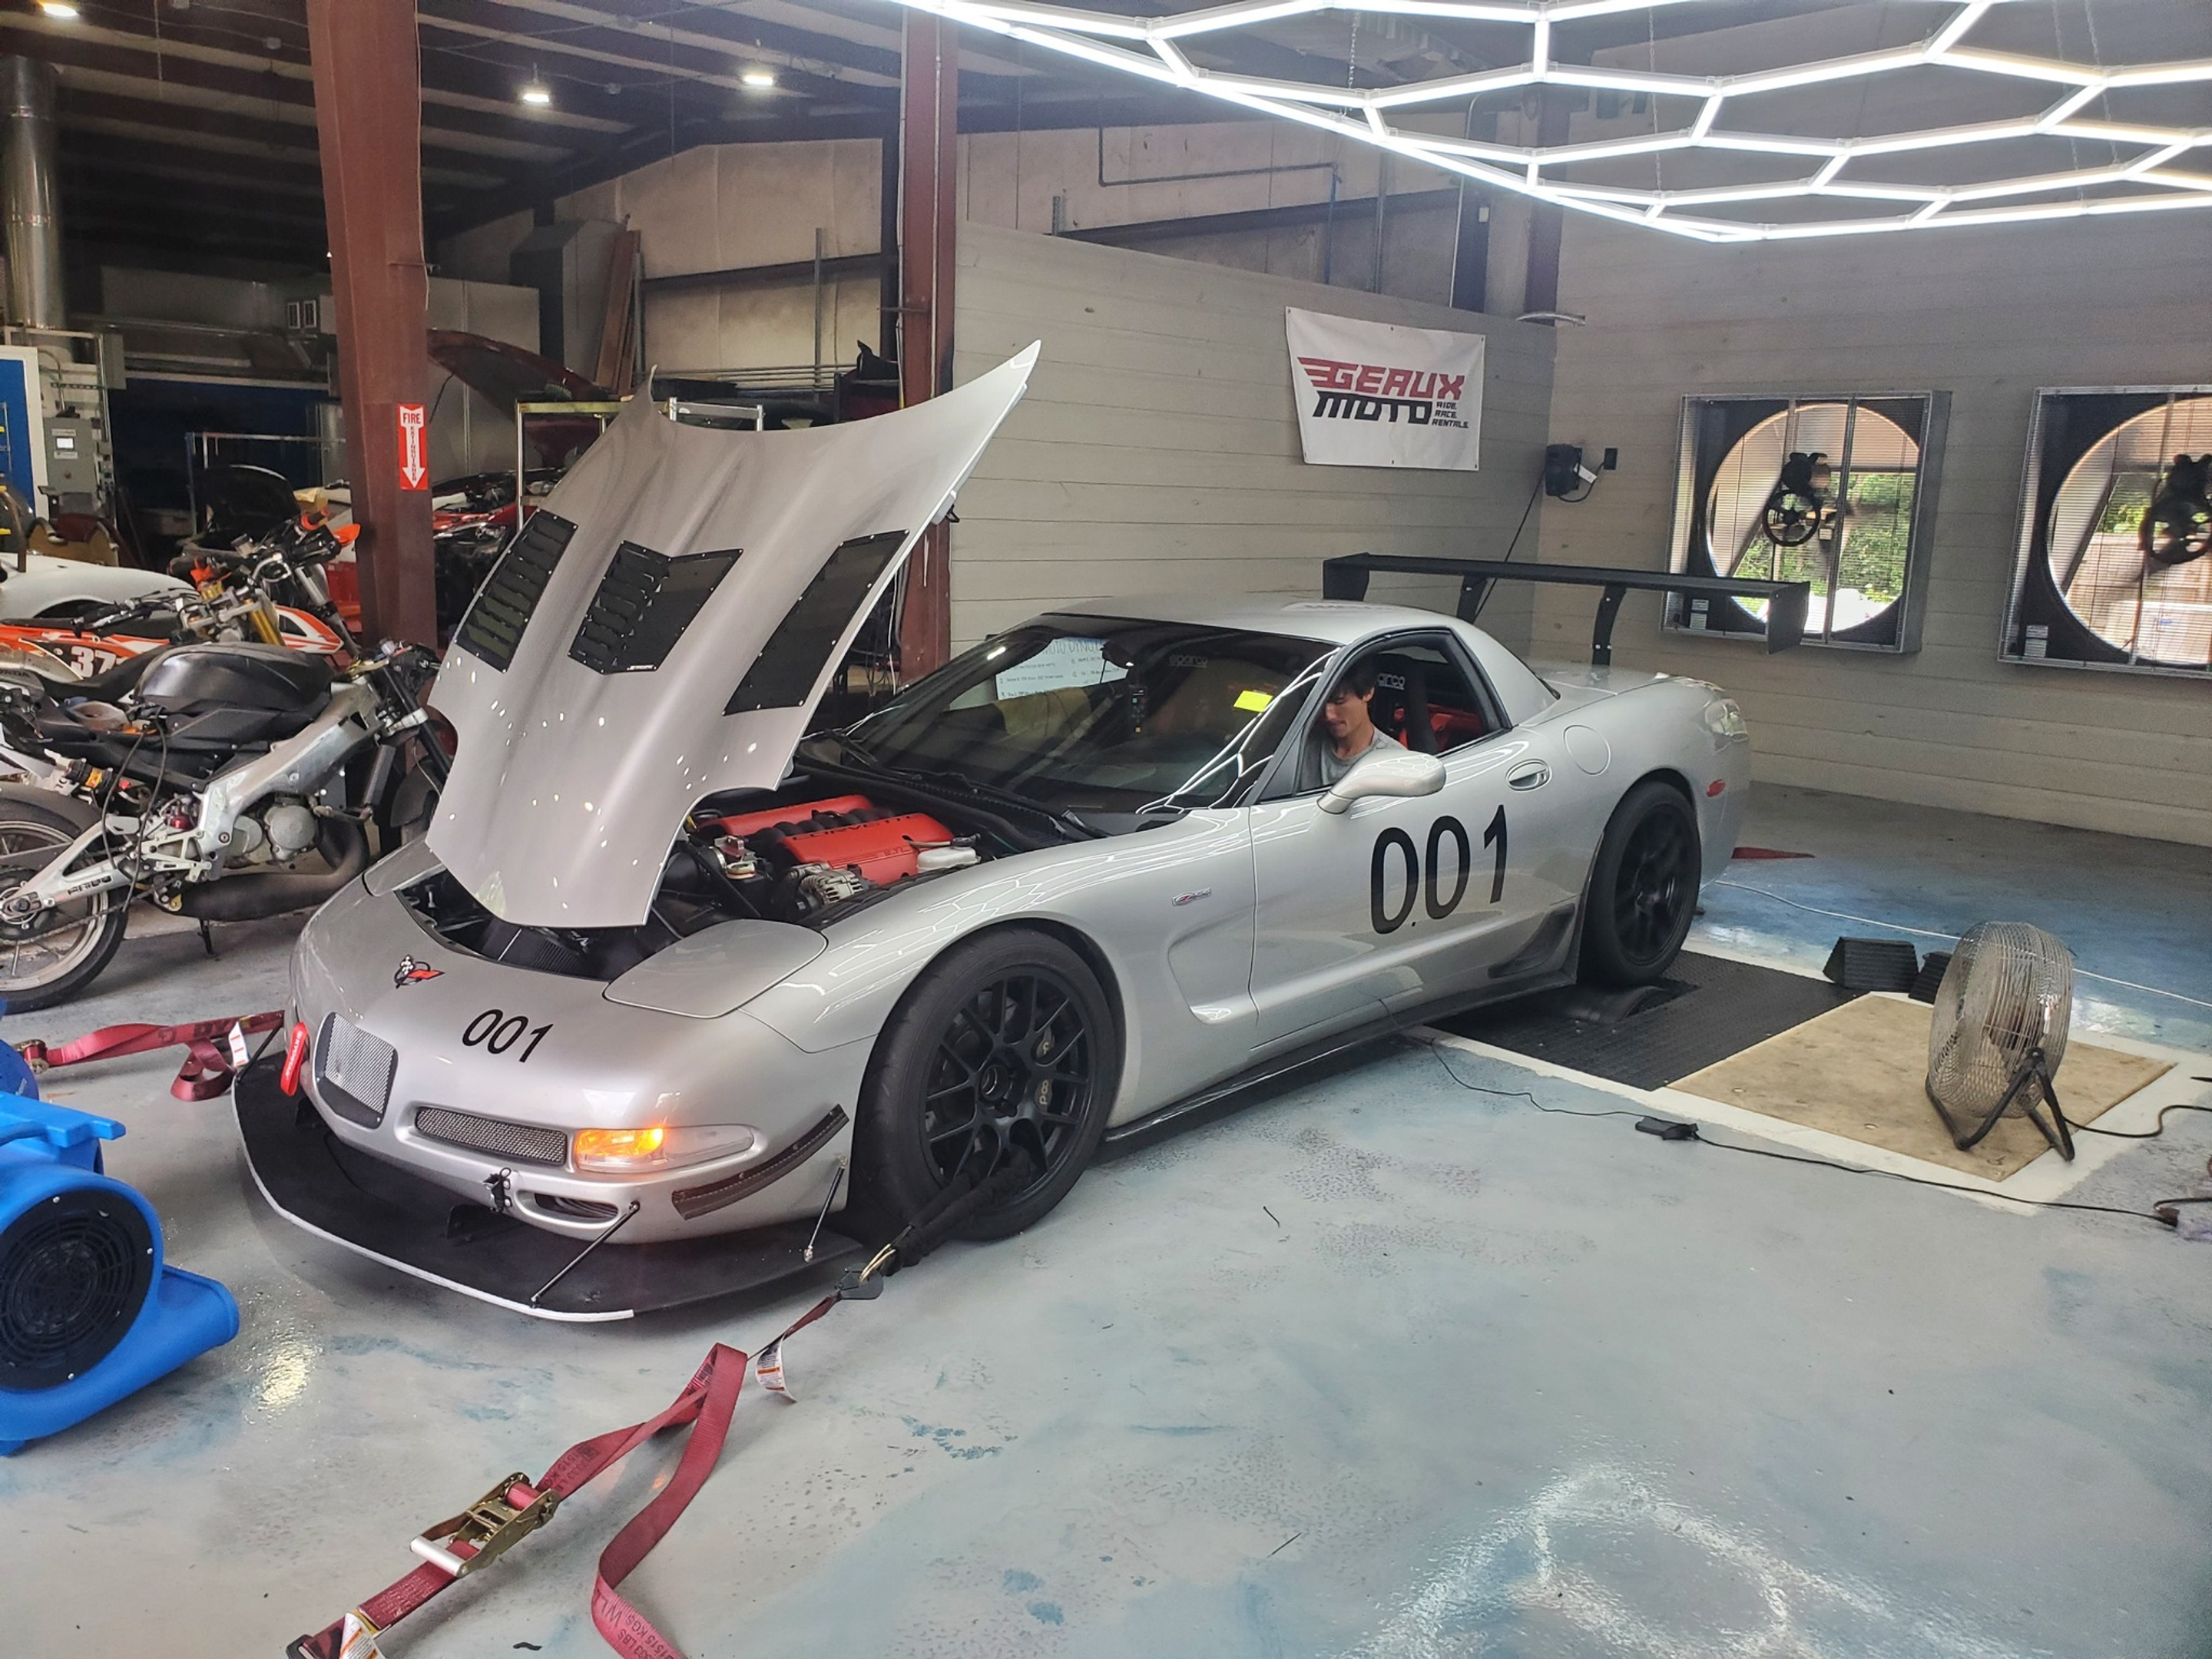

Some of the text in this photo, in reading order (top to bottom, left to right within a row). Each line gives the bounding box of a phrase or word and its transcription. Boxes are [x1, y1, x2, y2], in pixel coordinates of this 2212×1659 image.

[1297, 357, 1465, 400] GEAUX
[403, 412, 421, 424] FIRE
[1313, 390, 1432, 425] MOTO
[1169, 654, 1208, 667] sparco
[1378, 673, 1405, 690] arco
[1371, 804, 1508, 935] 001
[462, 1008, 554, 1063] 001
[618, 1629, 637, 1649] LBS
[625, 1615, 667, 1657] 1515 KGS
